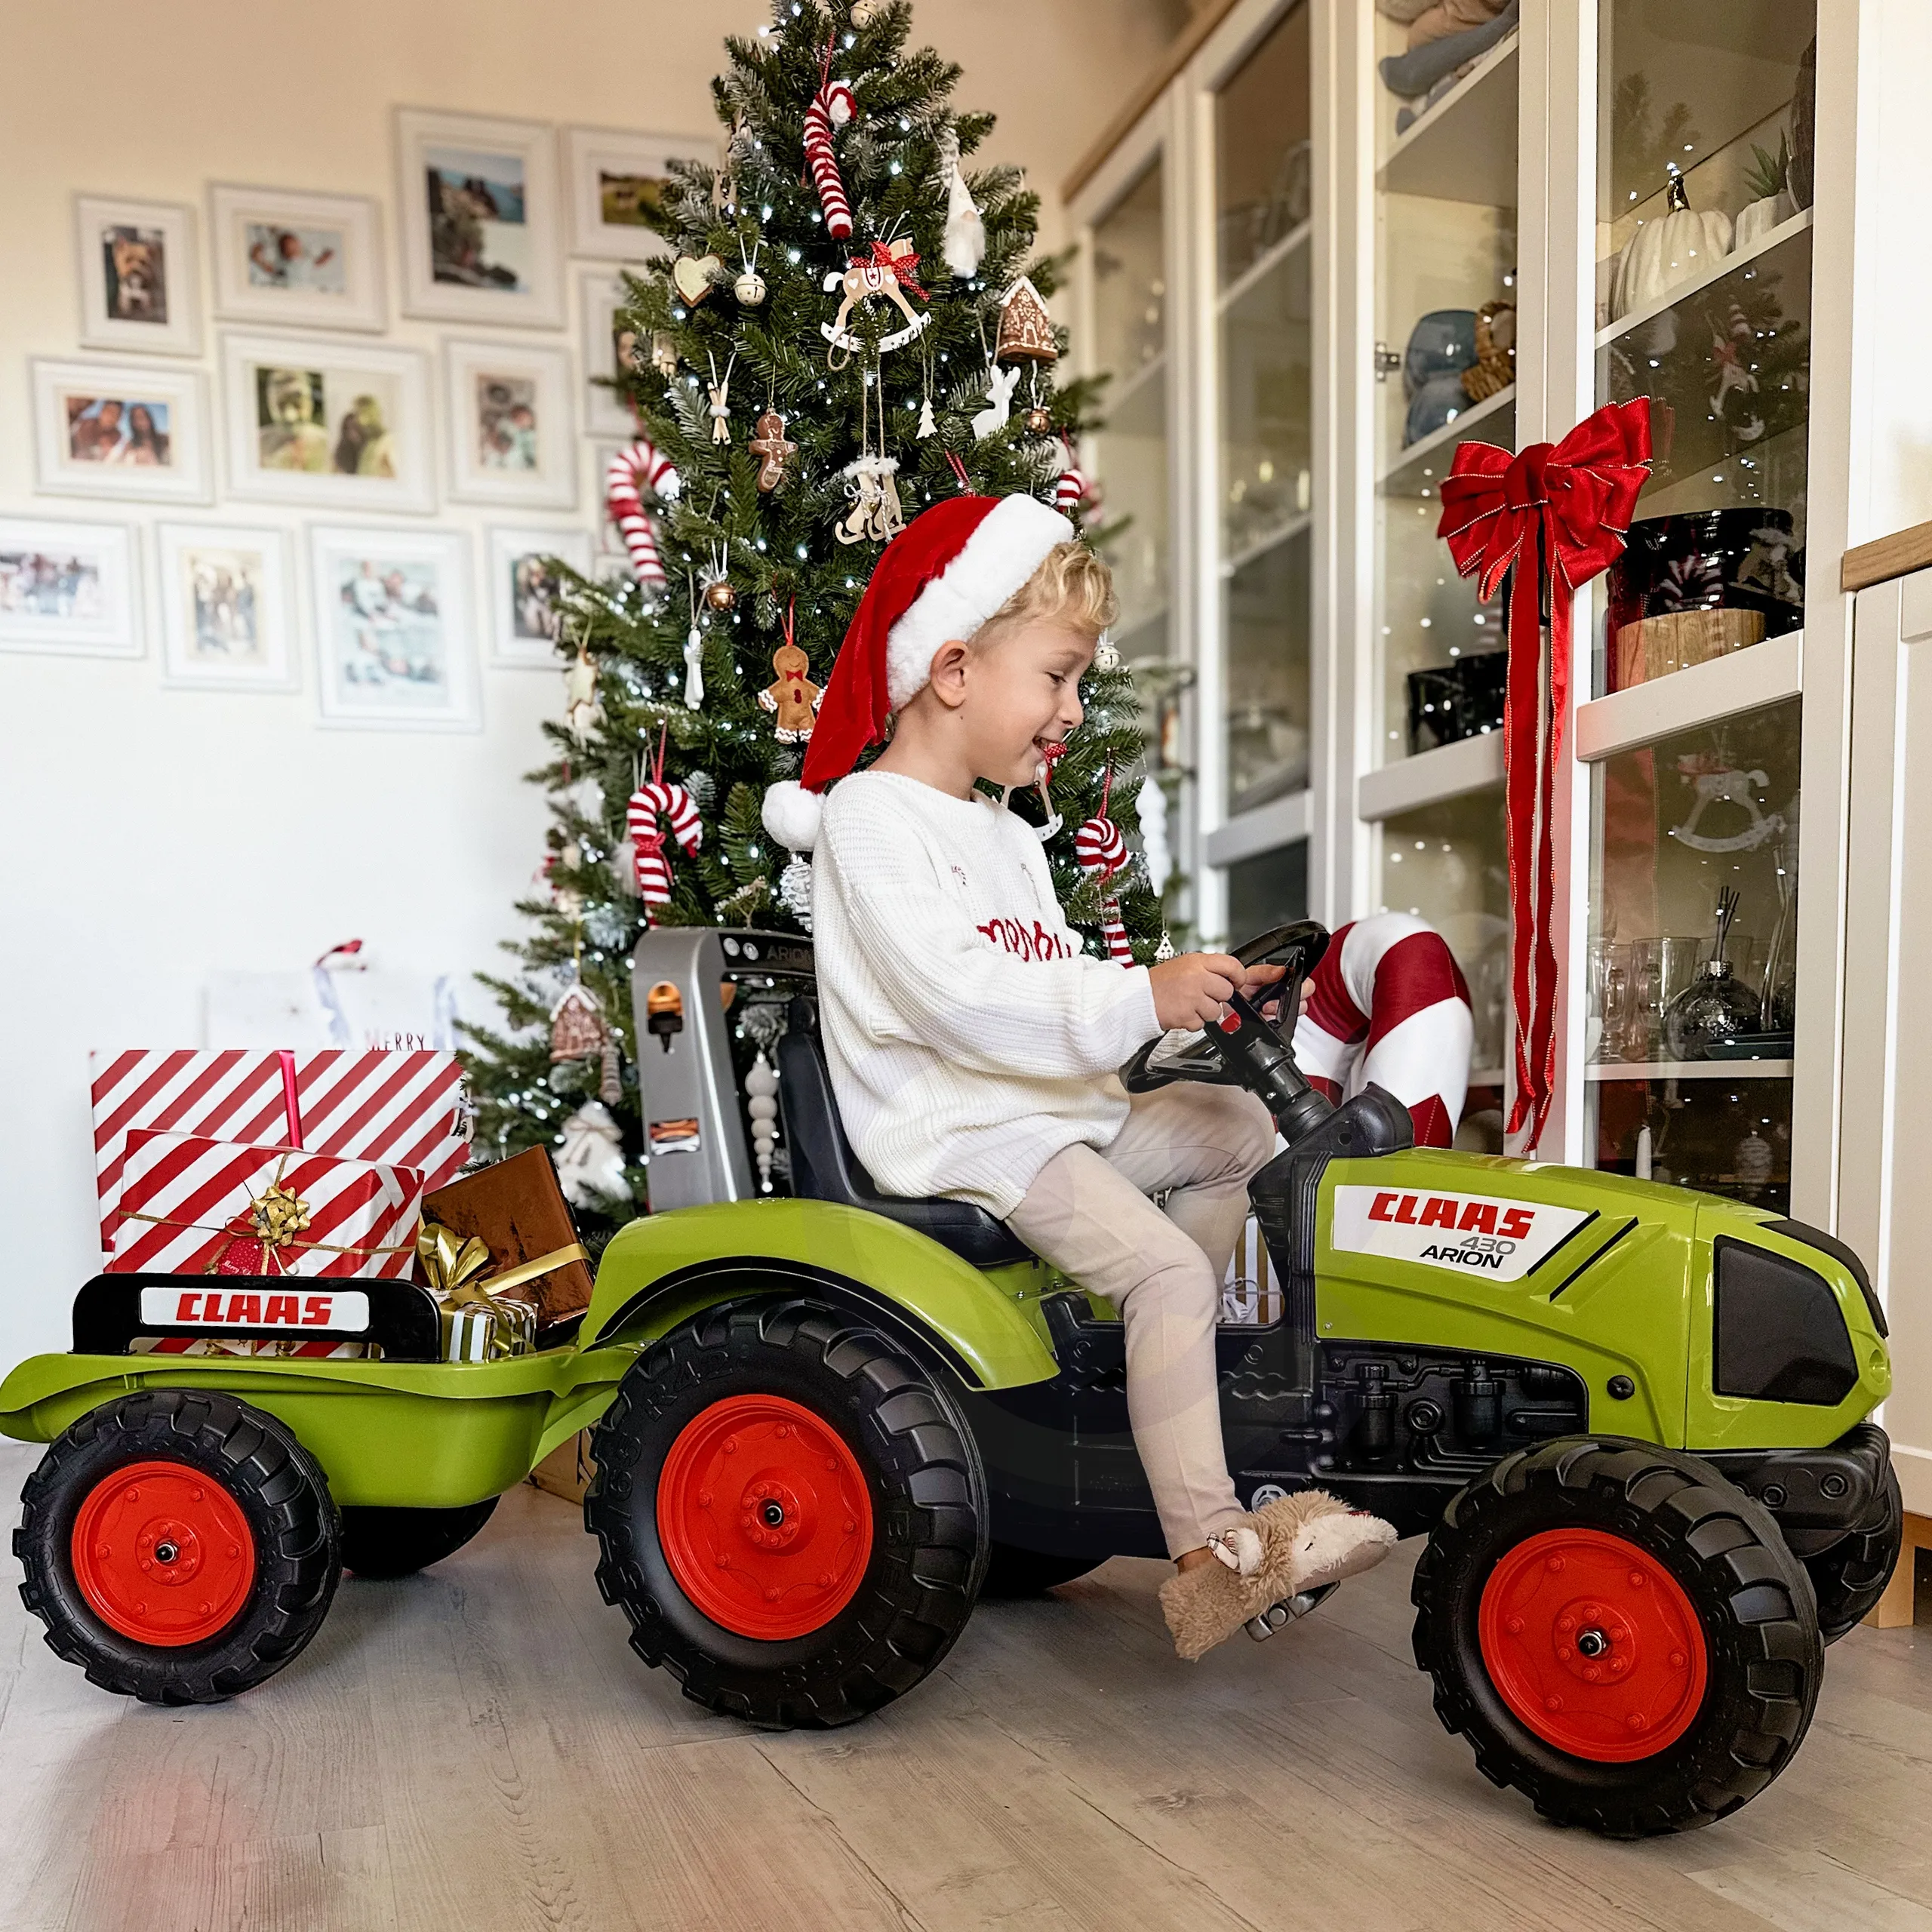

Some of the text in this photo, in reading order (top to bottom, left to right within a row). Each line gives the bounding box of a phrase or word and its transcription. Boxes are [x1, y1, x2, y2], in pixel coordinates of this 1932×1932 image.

[365, 1030, 426, 1051] MERRY
[1368, 1192, 1535, 1240] CLAAS
[1419, 1245, 1504, 1269] ARION
[1460, 1236, 1516, 1254] 430
[176, 1293, 333, 1325] CLAAS
